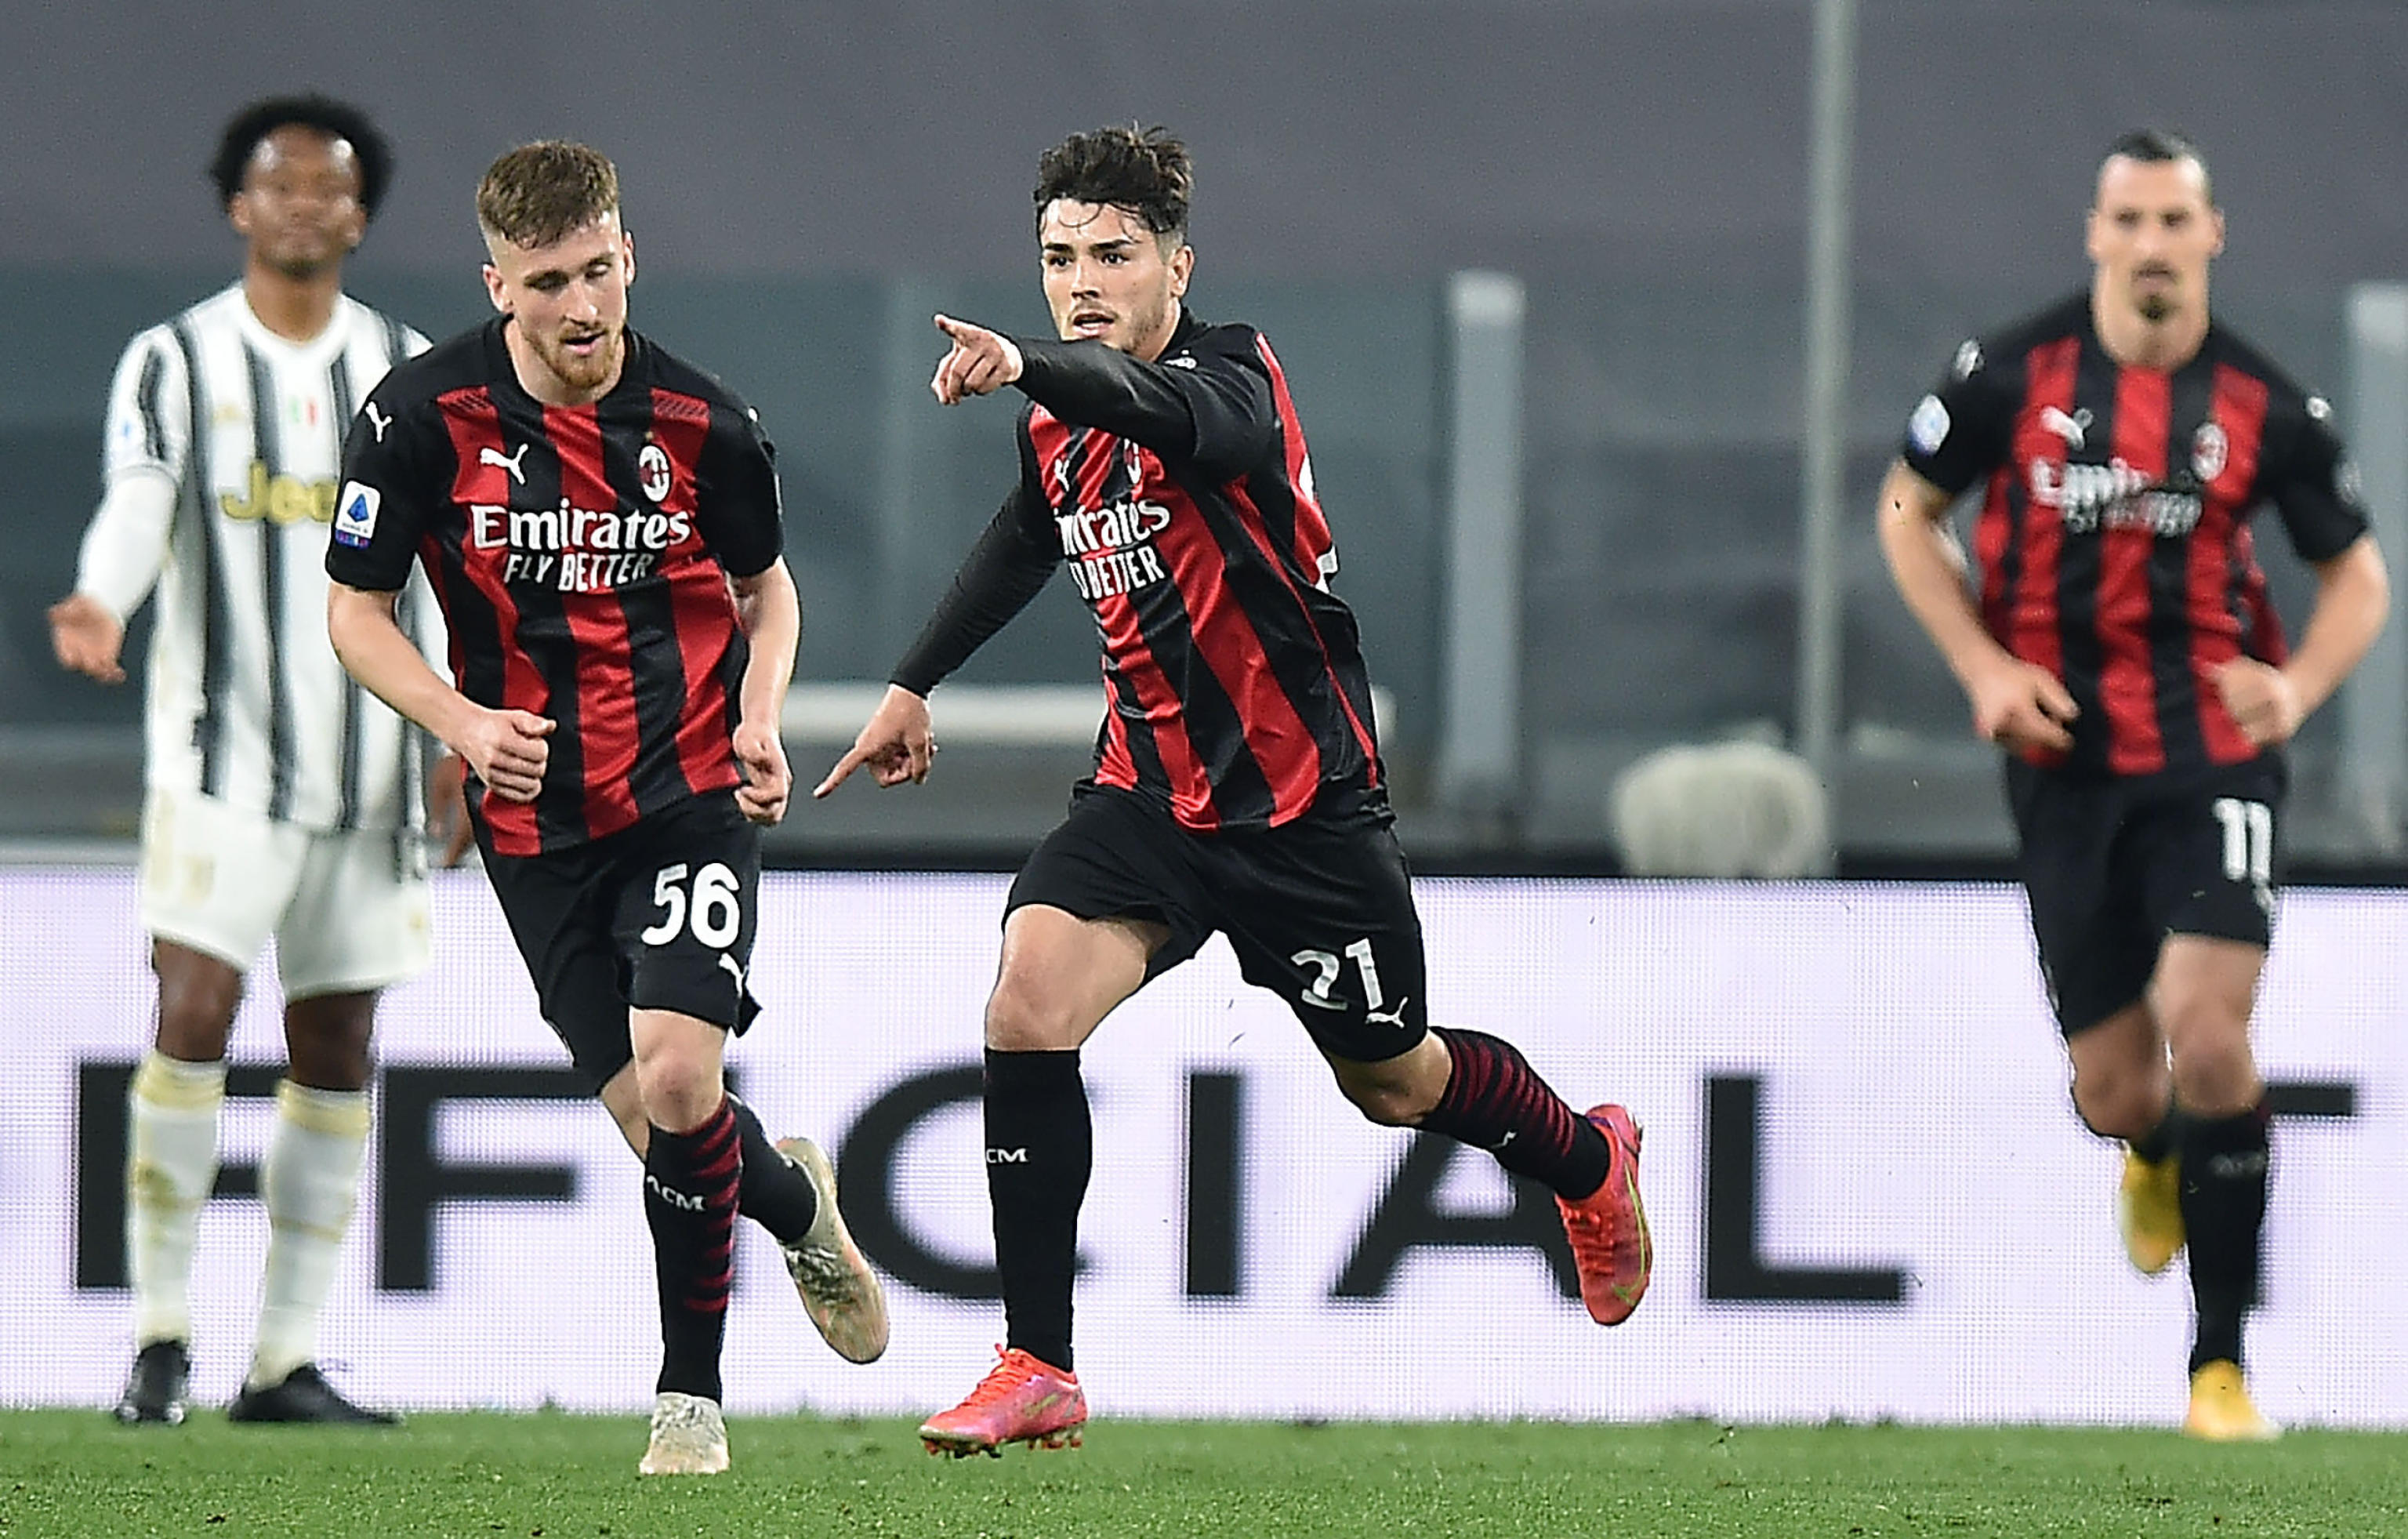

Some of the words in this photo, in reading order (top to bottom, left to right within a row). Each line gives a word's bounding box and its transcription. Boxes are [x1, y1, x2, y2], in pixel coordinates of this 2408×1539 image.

[470, 497, 691, 550] Emirates
[503, 554, 554, 584] FLY
[557, 552, 655, 592] BETTER
[1085, 546, 1166, 600] BETTER
[2213, 797, 2272, 884] 11
[640, 862, 740, 949] 56
[1290, 938, 1384, 1011] 21
[77, 1060, 1908, 1301] FFCIAL
